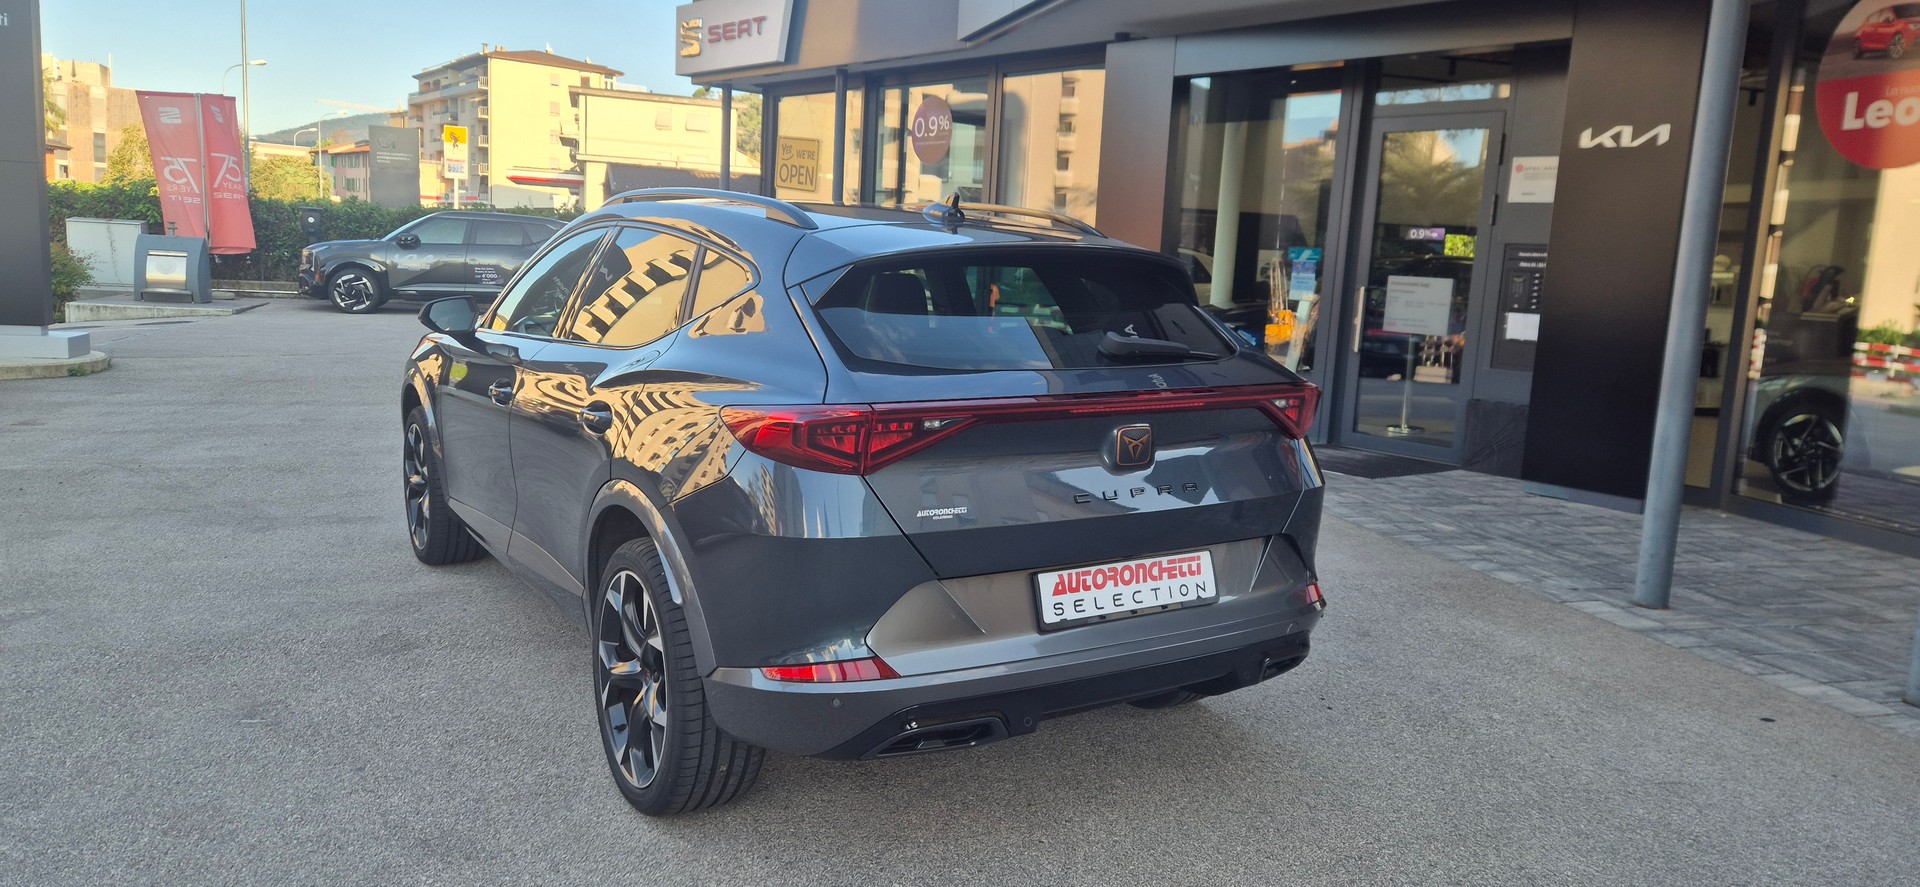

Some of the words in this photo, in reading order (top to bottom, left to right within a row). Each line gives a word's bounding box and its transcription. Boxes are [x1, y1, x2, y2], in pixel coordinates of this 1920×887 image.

[707, 15, 767, 43] SEAT
[1842, 91, 1920, 130] Leo
[914, 115, 950, 138] 0.9%
[1578, 123, 1671, 149] KIA
[796, 149, 816, 160] WE'RE
[210, 152, 241, 188] 75
[779, 163, 815, 186] OPEN
[1073, 482, 1199, 504] CUPRA
[916, 506, 968, 518] AUTORONCHETTI
[1052, 555, 1202, 597] AUTORONCHETTI
[1053, 581, 1207, 616] SELECTION
